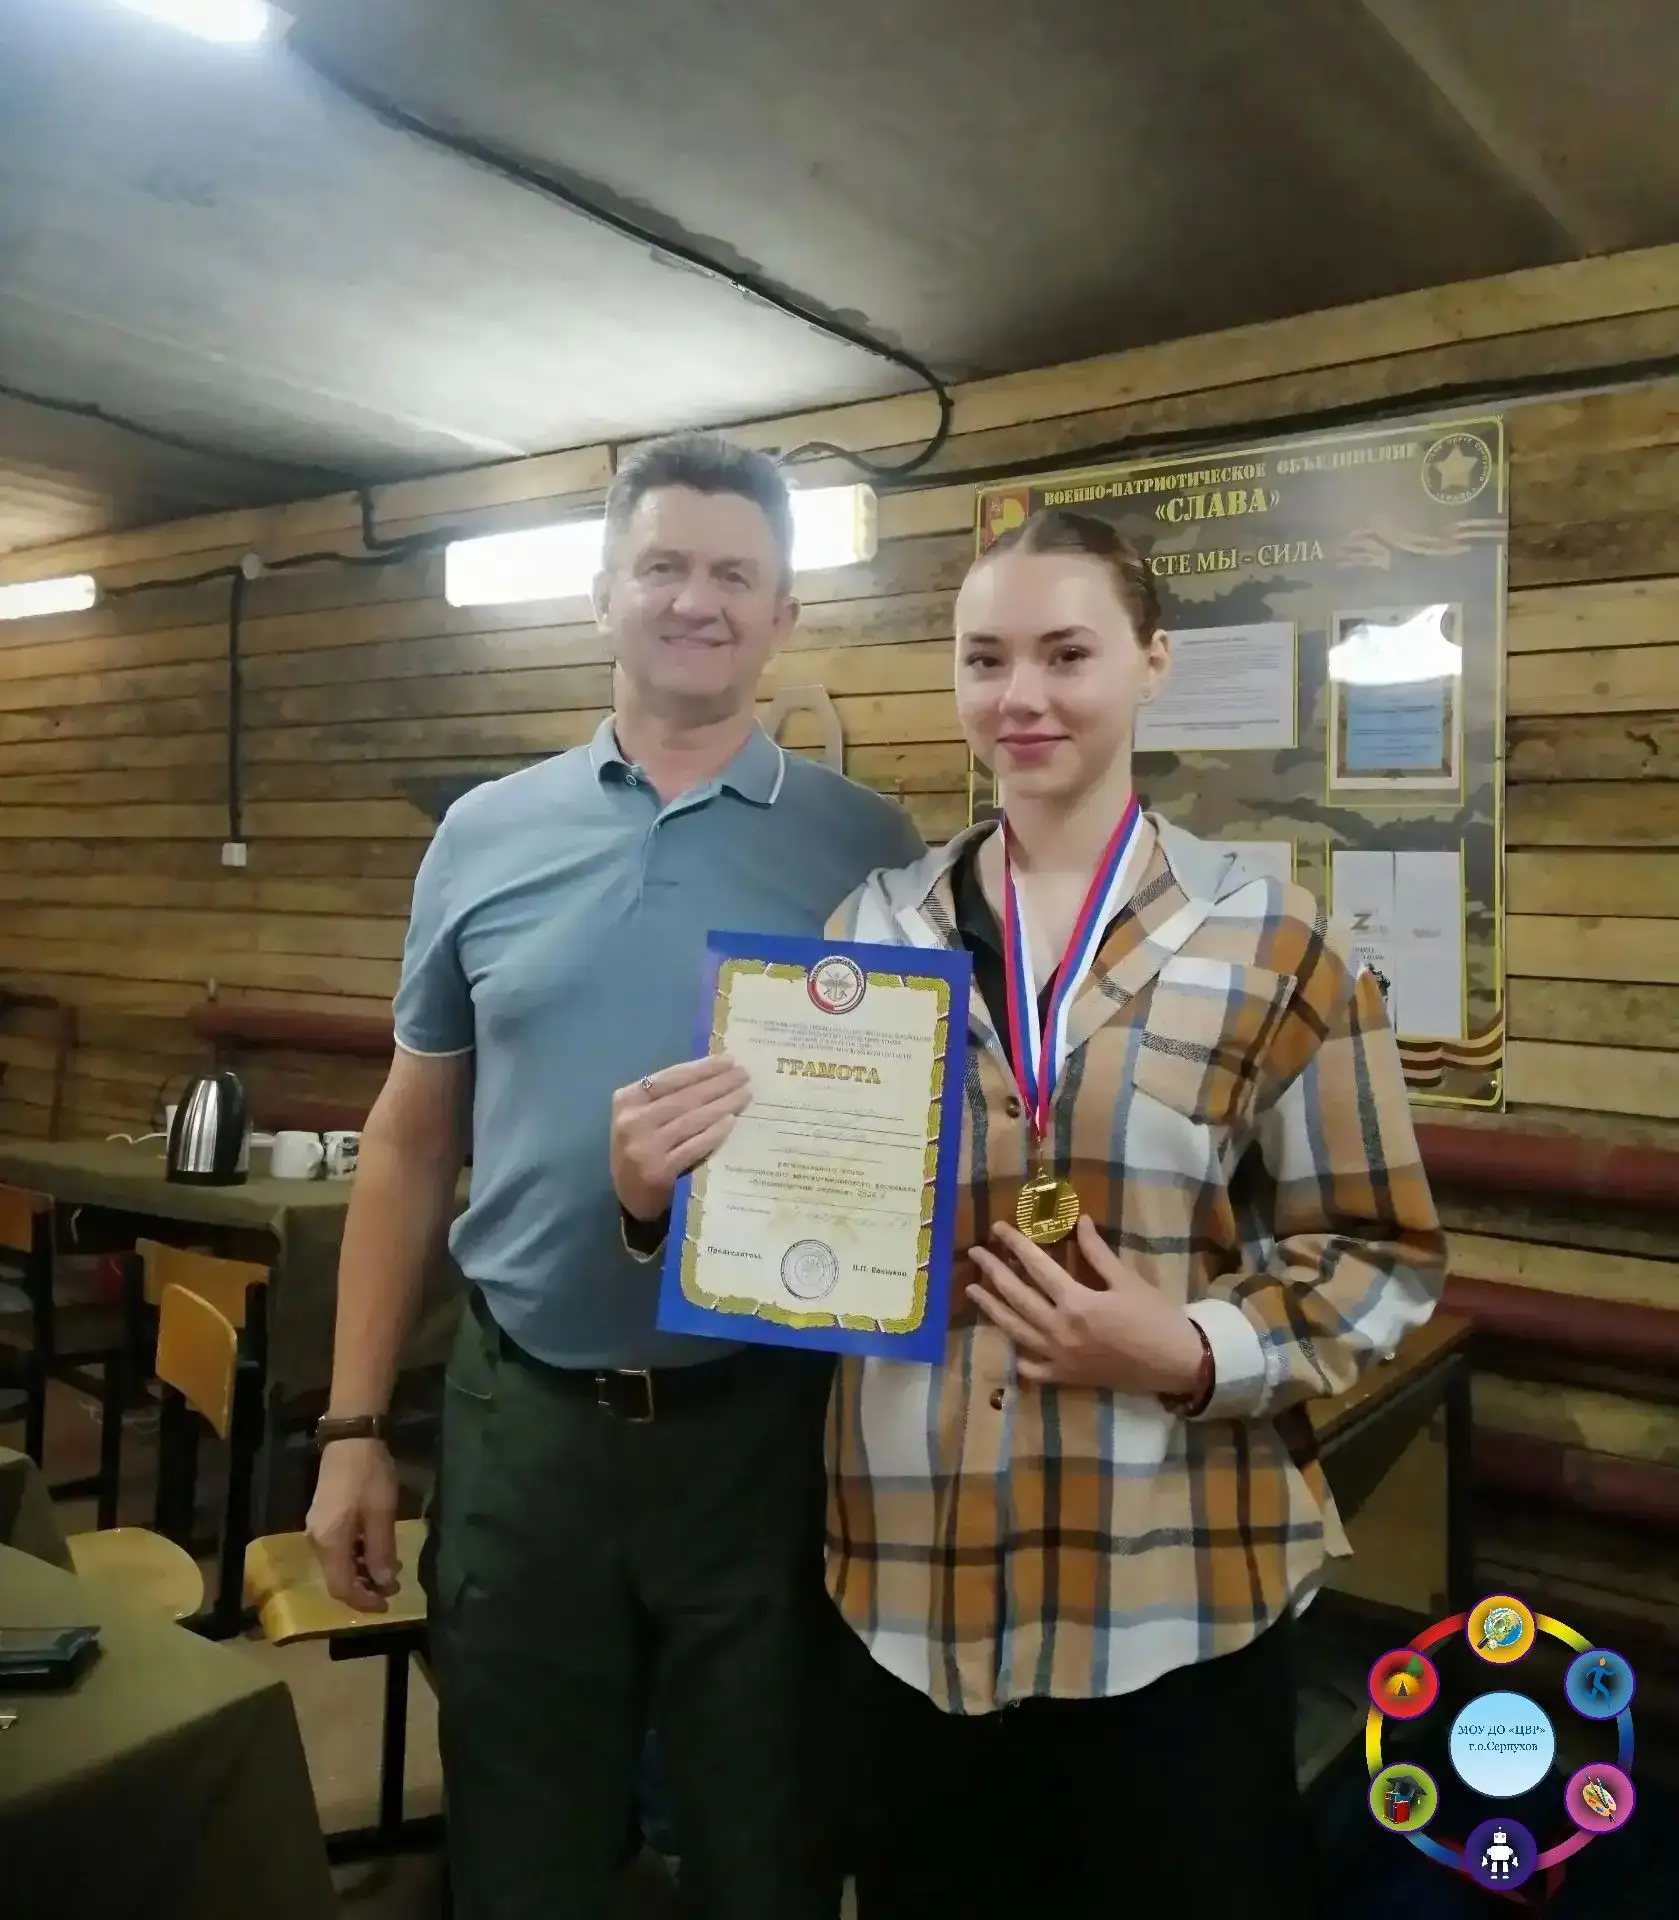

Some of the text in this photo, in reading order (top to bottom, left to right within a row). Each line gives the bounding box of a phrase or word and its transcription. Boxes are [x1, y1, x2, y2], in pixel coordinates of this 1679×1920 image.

[1044, 462, 1267, 506] ВОЕННО-ПАТРИОТИЧЕСКОЕ
[1155, 487, 1280, 524] «СЛАВА»
[1145, 553, 1191, 577] СТЕ
[1197, 548, 1238, 573] МЫ
[1257, 540, 1325, 567] СИЛА
[776, 1056, 881, 1085] ГРАМОТА
